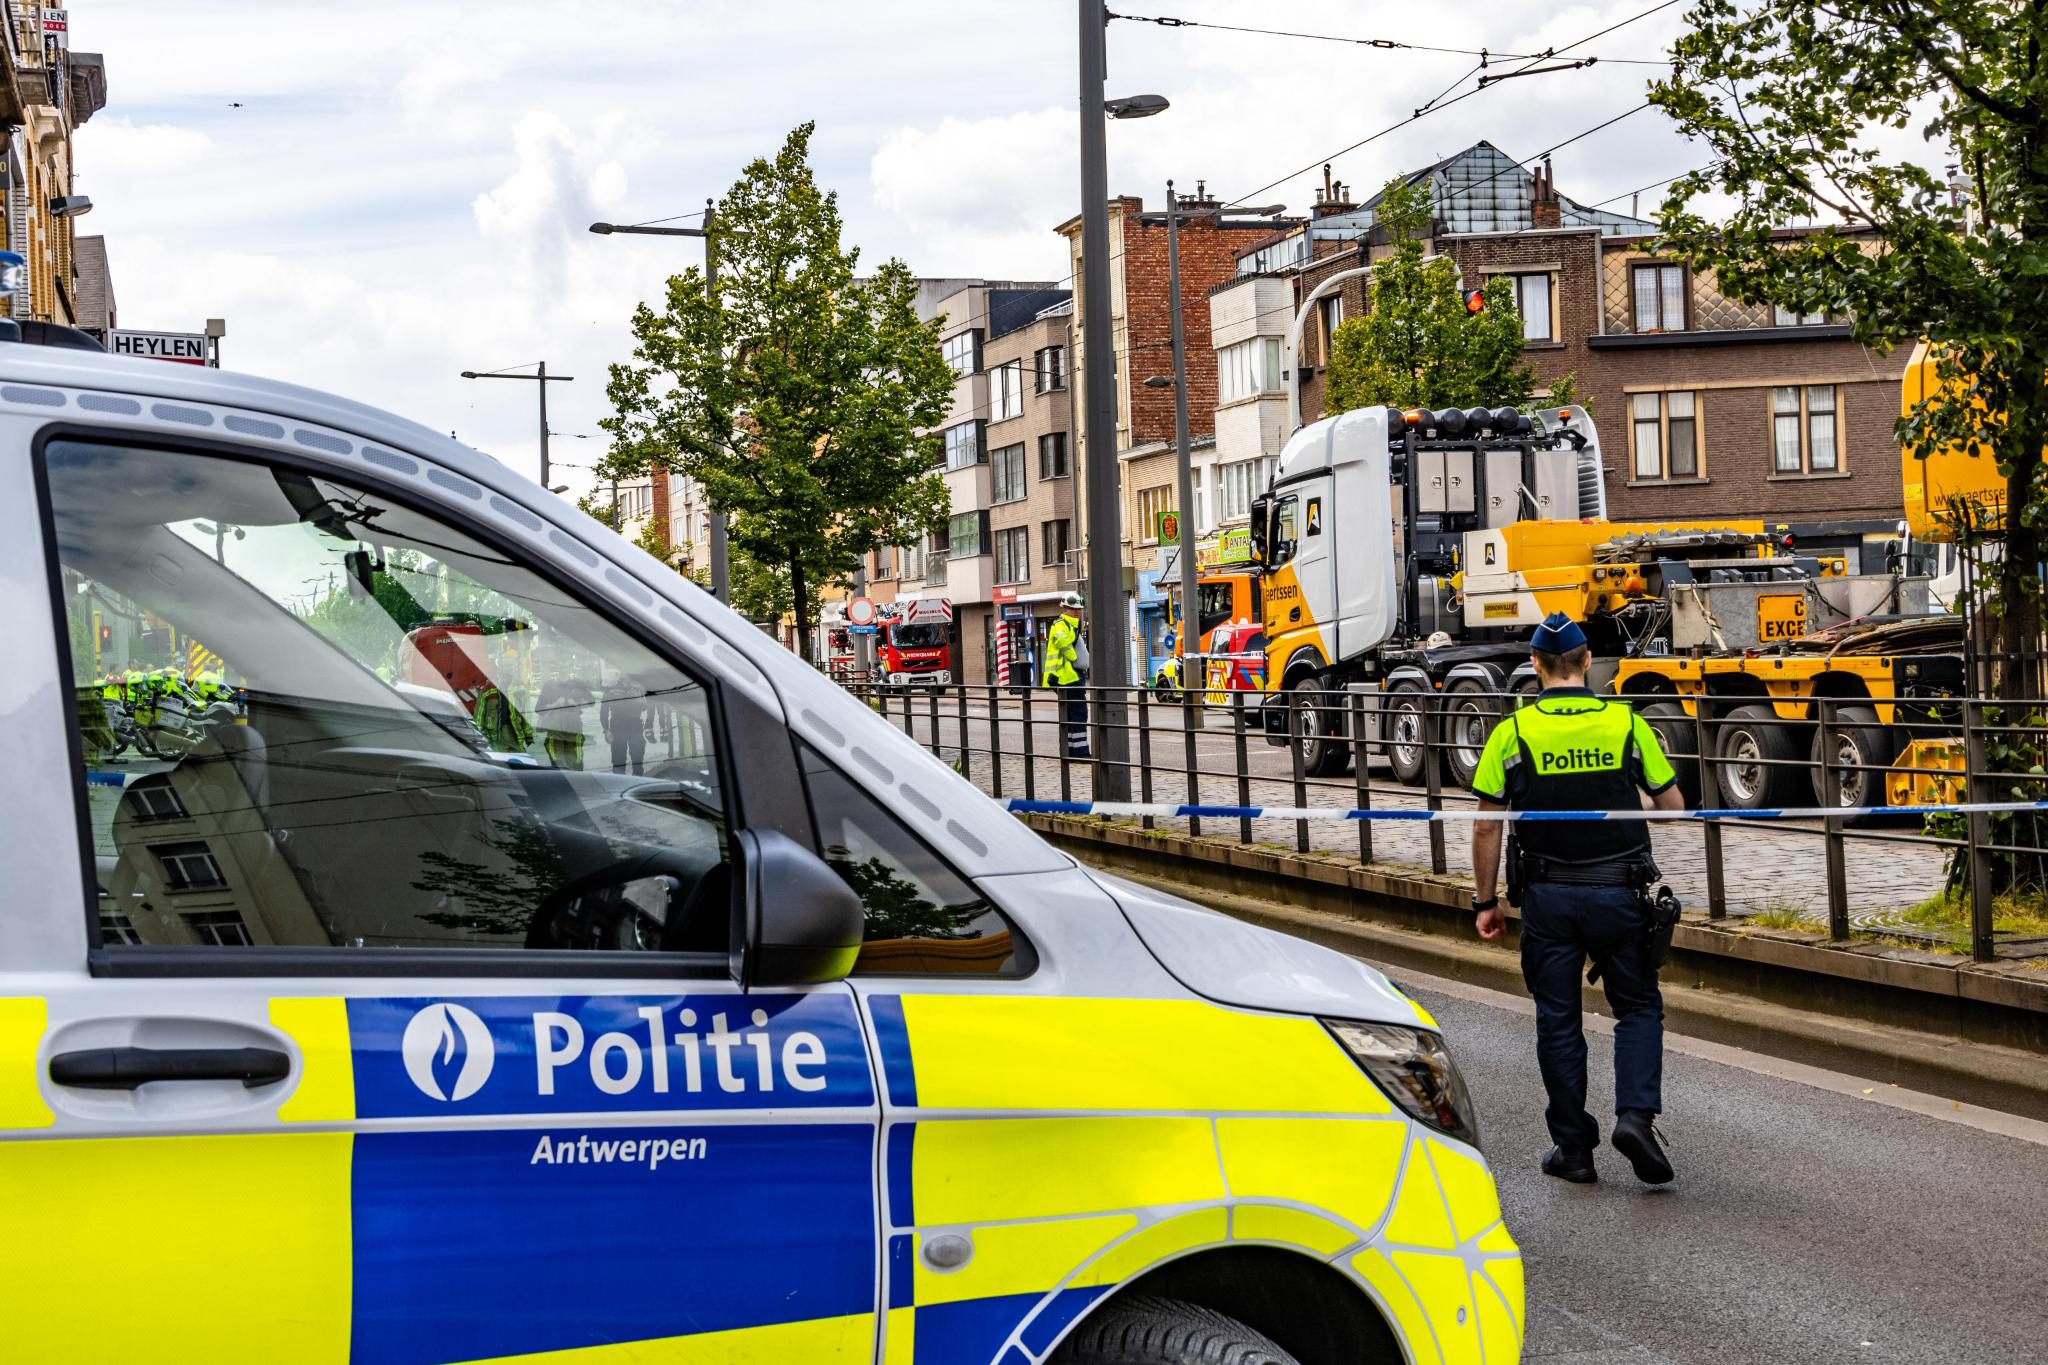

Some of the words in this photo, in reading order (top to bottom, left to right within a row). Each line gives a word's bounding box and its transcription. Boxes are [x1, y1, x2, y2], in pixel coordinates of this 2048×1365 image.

[43, 12, 65, 21] LEN
[115, 336, 202, 357] HEYLEN
[1766, 620, 1807, 637] EXCE
[1541, 747, 1615, 771] Politie
[533, 1005, 827, 1097] Politie
[530, 1134, 707, 1171] Antwerpen
